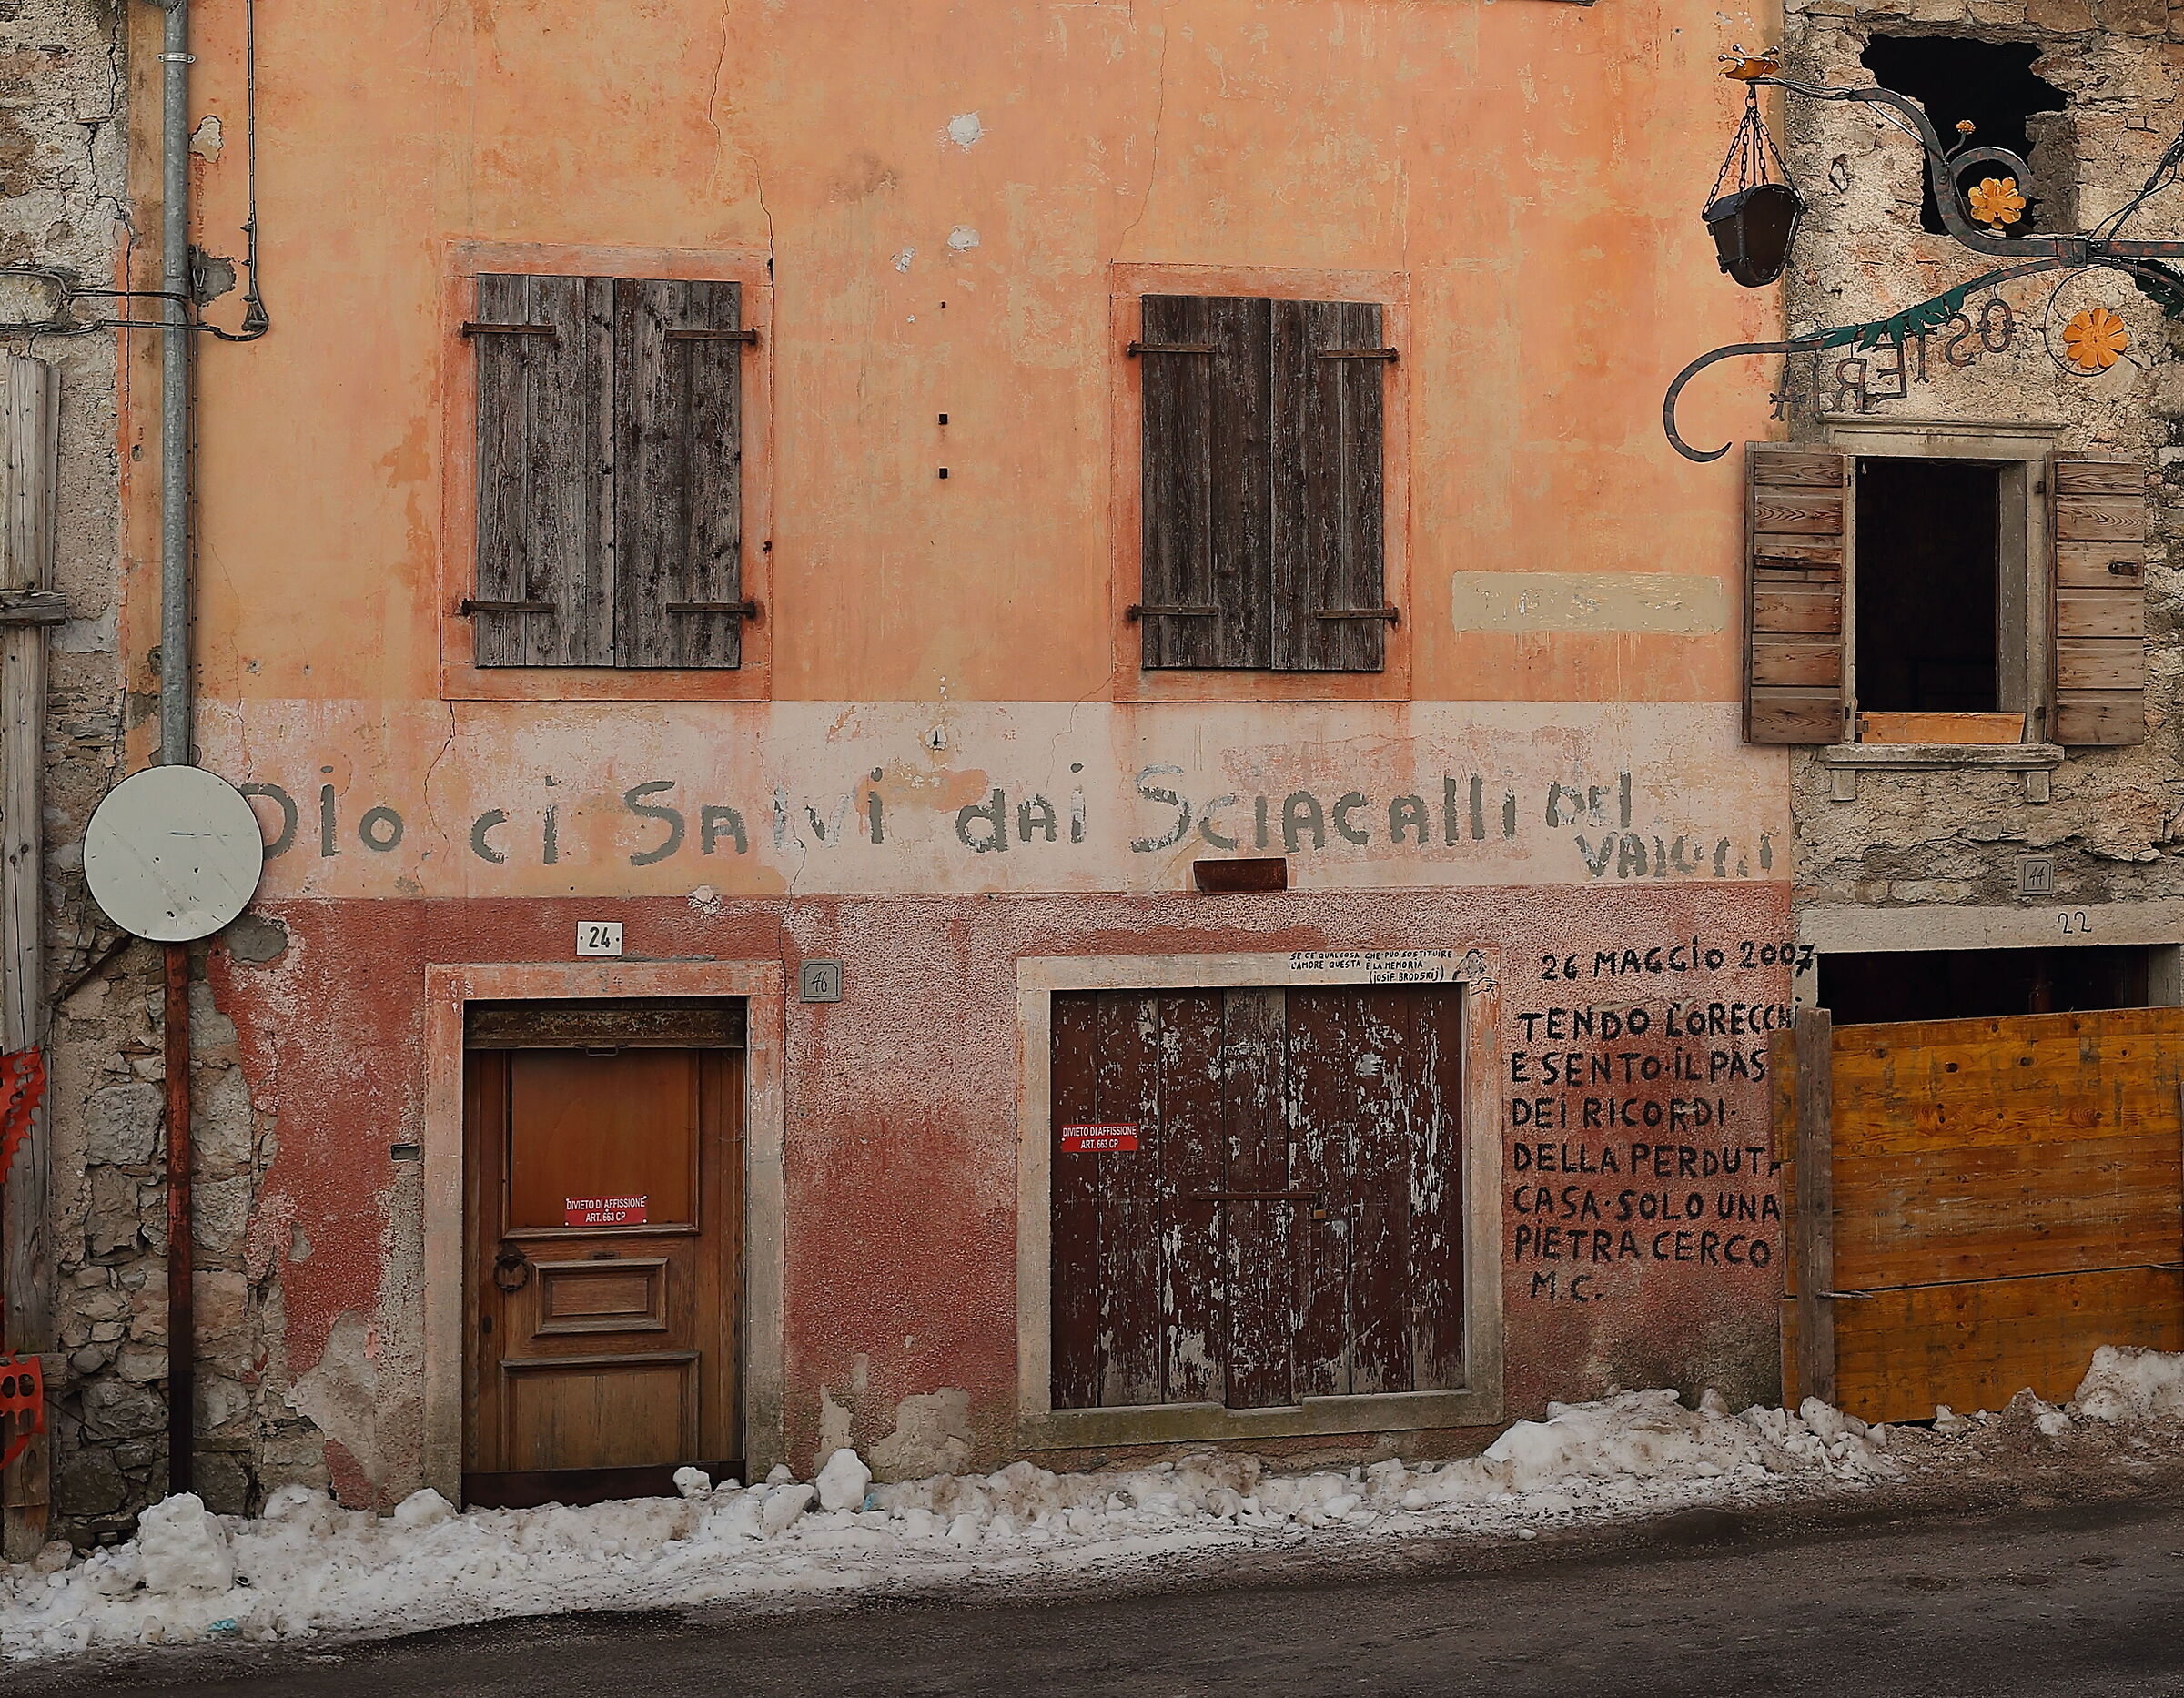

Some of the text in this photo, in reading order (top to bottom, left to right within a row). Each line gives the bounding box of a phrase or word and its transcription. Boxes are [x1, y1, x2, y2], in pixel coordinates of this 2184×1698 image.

[470, 775, 559, 865] ci
[2029, 866, 2045, 886] 44
[2058, 911, 2092, 935] 22
[589, 926, 611, 948] 24
[1289, 952, 1301, 961] SE
[1319, 952, 1360, 960] QUALCOSA
[1365, 952, 1380, 960] CHE
[1290, 960, 1324, 970] L'AMORE
[1329, 960, 1361, 969] QUESTA
[1373, 961, 1382, 970] LA
[1541, 953, 1579, 981] 26
[1738, 941, 1816, 977] 2007
[811, 970, 828, 993] 46
[1517, 1005, 1650, 1043] TENDO
[1510, 1051, 1531, 1084] E
[1710, 1048, 1768, 1083] PAS
[1512, 1092, 1566, 1129] DEI
[1062, 1126, 1137, 1137] DIVIETO DI AFFISSIONE
[1081, 1138, 1119, 1149] ART. 663 CP
[1513, 1142, 1620, 1174] DELLA
[566, 1198, 645, 1210] DIVIETO DI AFFISSIONE
[1614, 1189, 1704, 1222] SOLO
[1717, 1191, 1781, 1223] UNA
[585, 1211, 626, 1222] ART. 663 CP
[1652, 1229, 1771, 1268] CERCO
